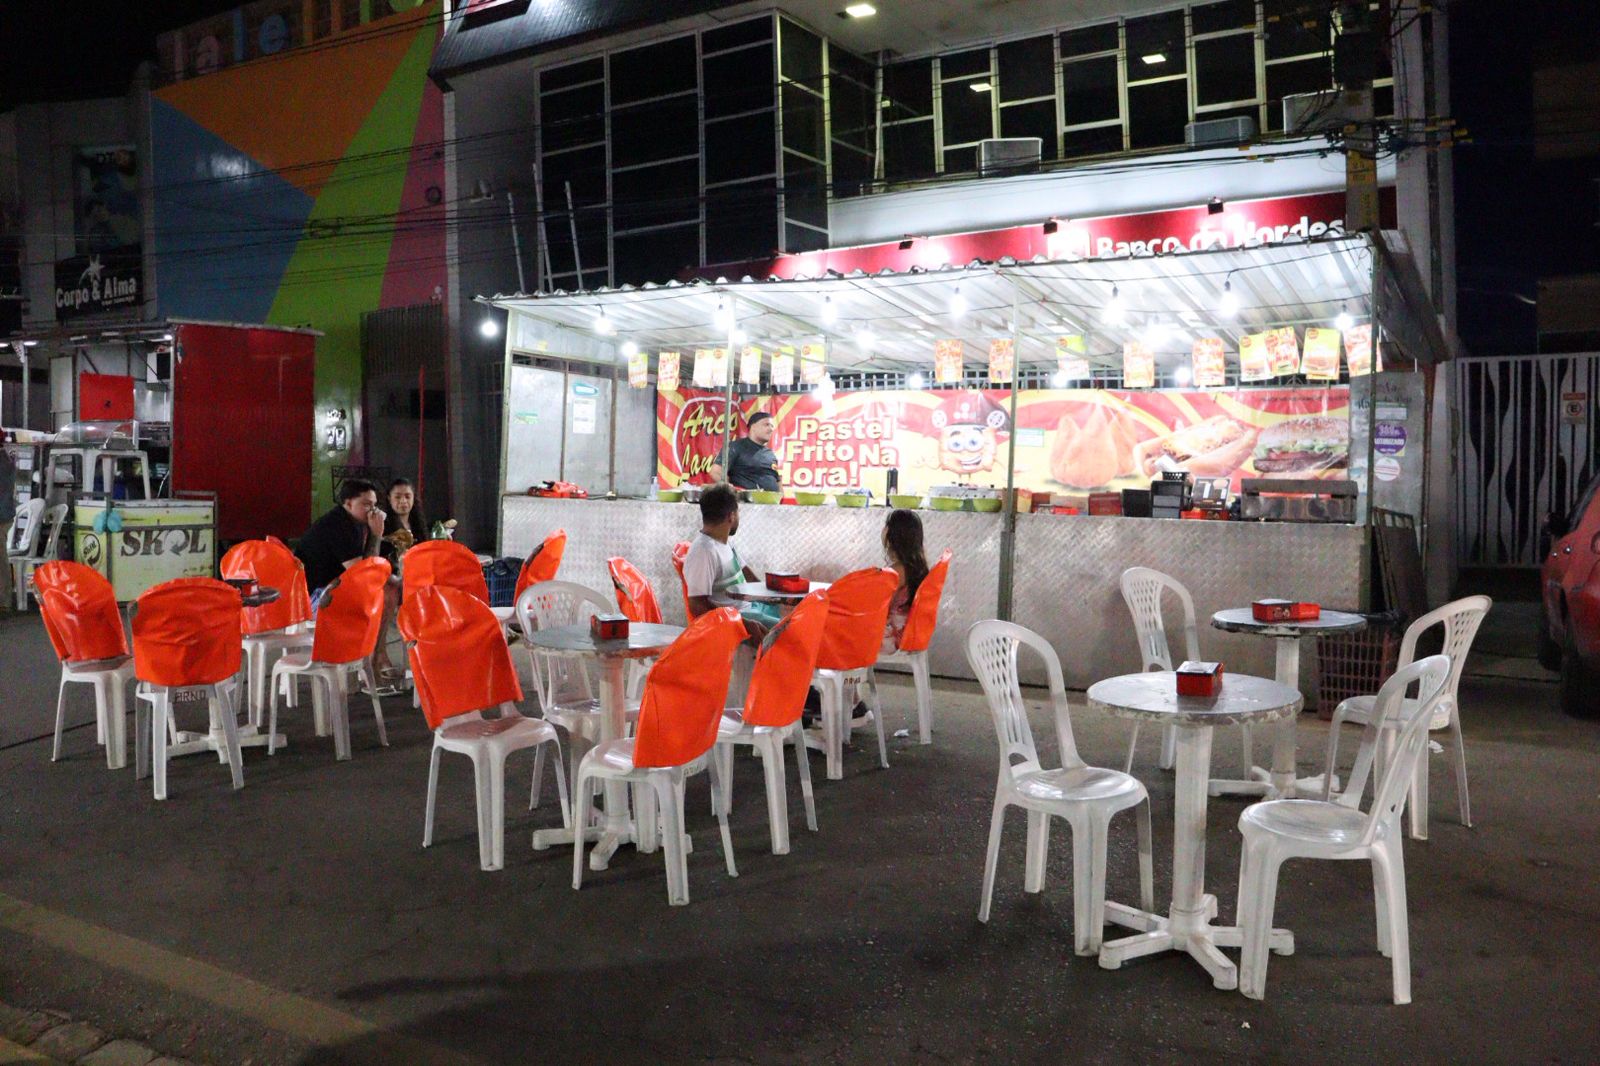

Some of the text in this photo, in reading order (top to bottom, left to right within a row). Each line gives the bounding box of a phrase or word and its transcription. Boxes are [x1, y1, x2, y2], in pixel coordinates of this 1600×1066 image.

[1097, 236, 1182, 258] Banco
[1232, 216, 1344, 247] Nordes
[56, 287, 89, 309] Corpo
[92, 280, 100, 300] &
[104, 277, 137, 297] Alma
[682, 403, 738, 440] Arco
[799, 418, 891, 441] Pastel
[786, 439, 897, 467] Frito Na
[121, 528, 206, 556] SKOL
